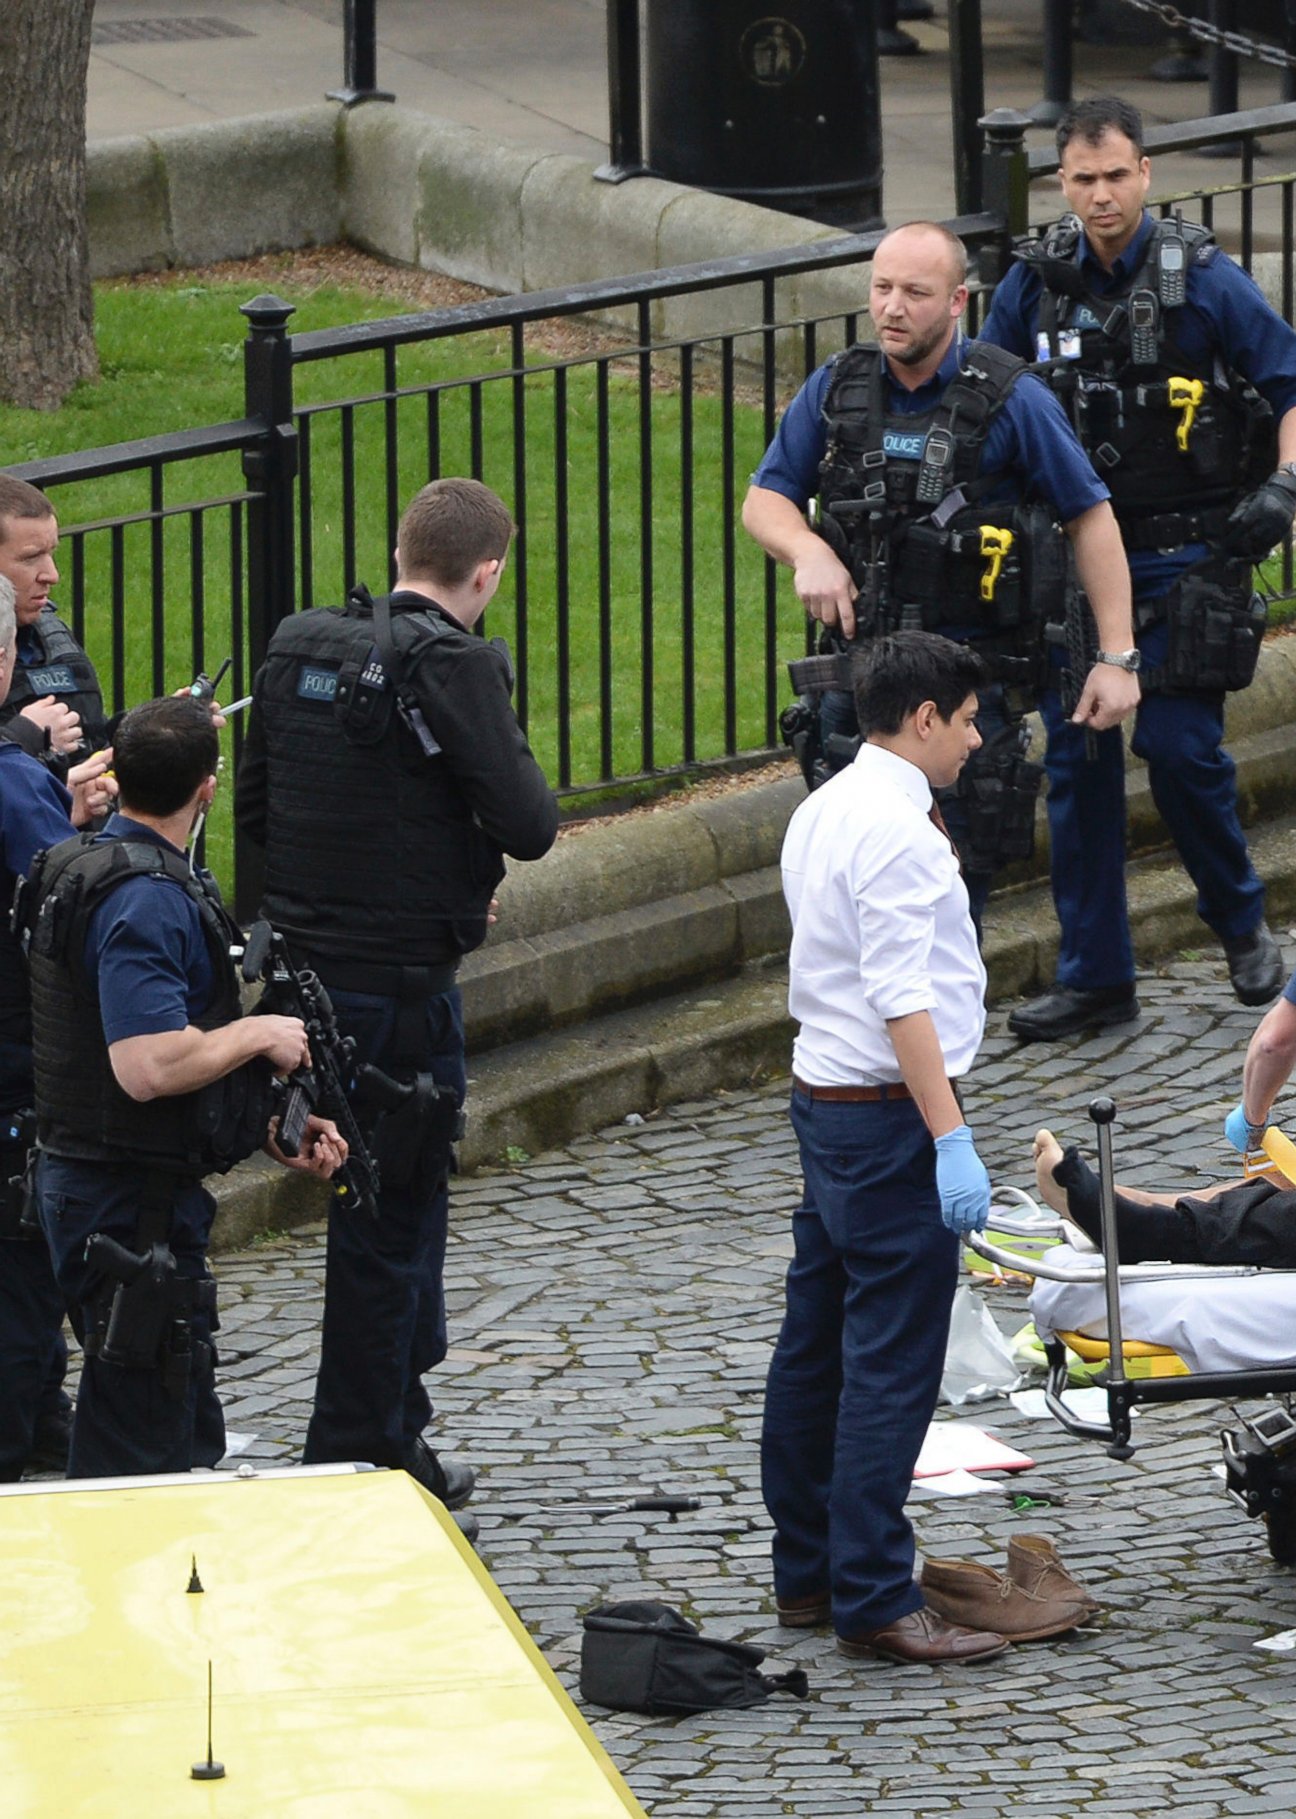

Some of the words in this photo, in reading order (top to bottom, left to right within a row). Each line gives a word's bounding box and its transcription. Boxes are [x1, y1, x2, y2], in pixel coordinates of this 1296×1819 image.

[883, 435, 921, 453] OLICE
[32, 671, 71, 688] POLICE
[305, 675, 337, 694] POLIC
